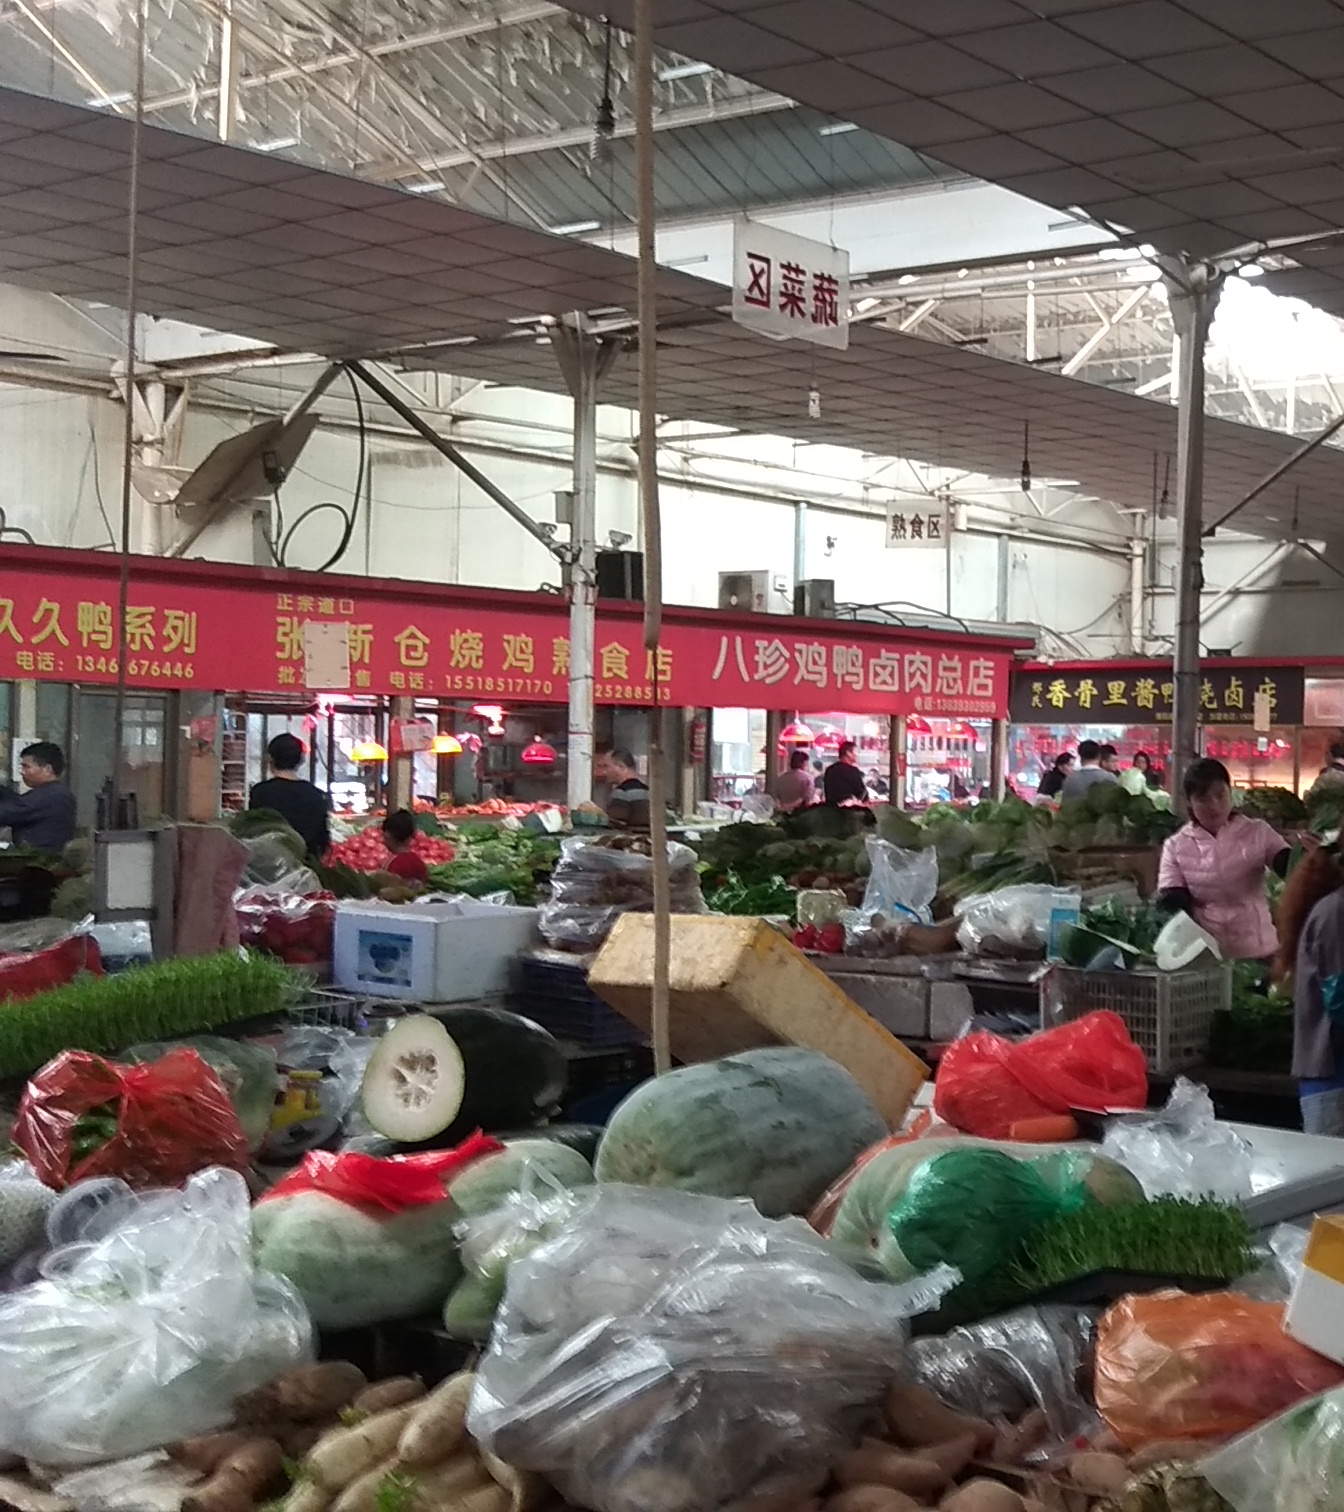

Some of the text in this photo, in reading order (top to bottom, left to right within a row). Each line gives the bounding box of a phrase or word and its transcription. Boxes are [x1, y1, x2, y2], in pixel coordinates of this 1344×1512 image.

[891, 513, 941, 540] 熟食区
[277, 594, 354, 614] 正宗道口
[0, 597, 196, 654] 久久鸭系列
[712, 636, 995, 697] 八珍鸡鸭卤肉总店
